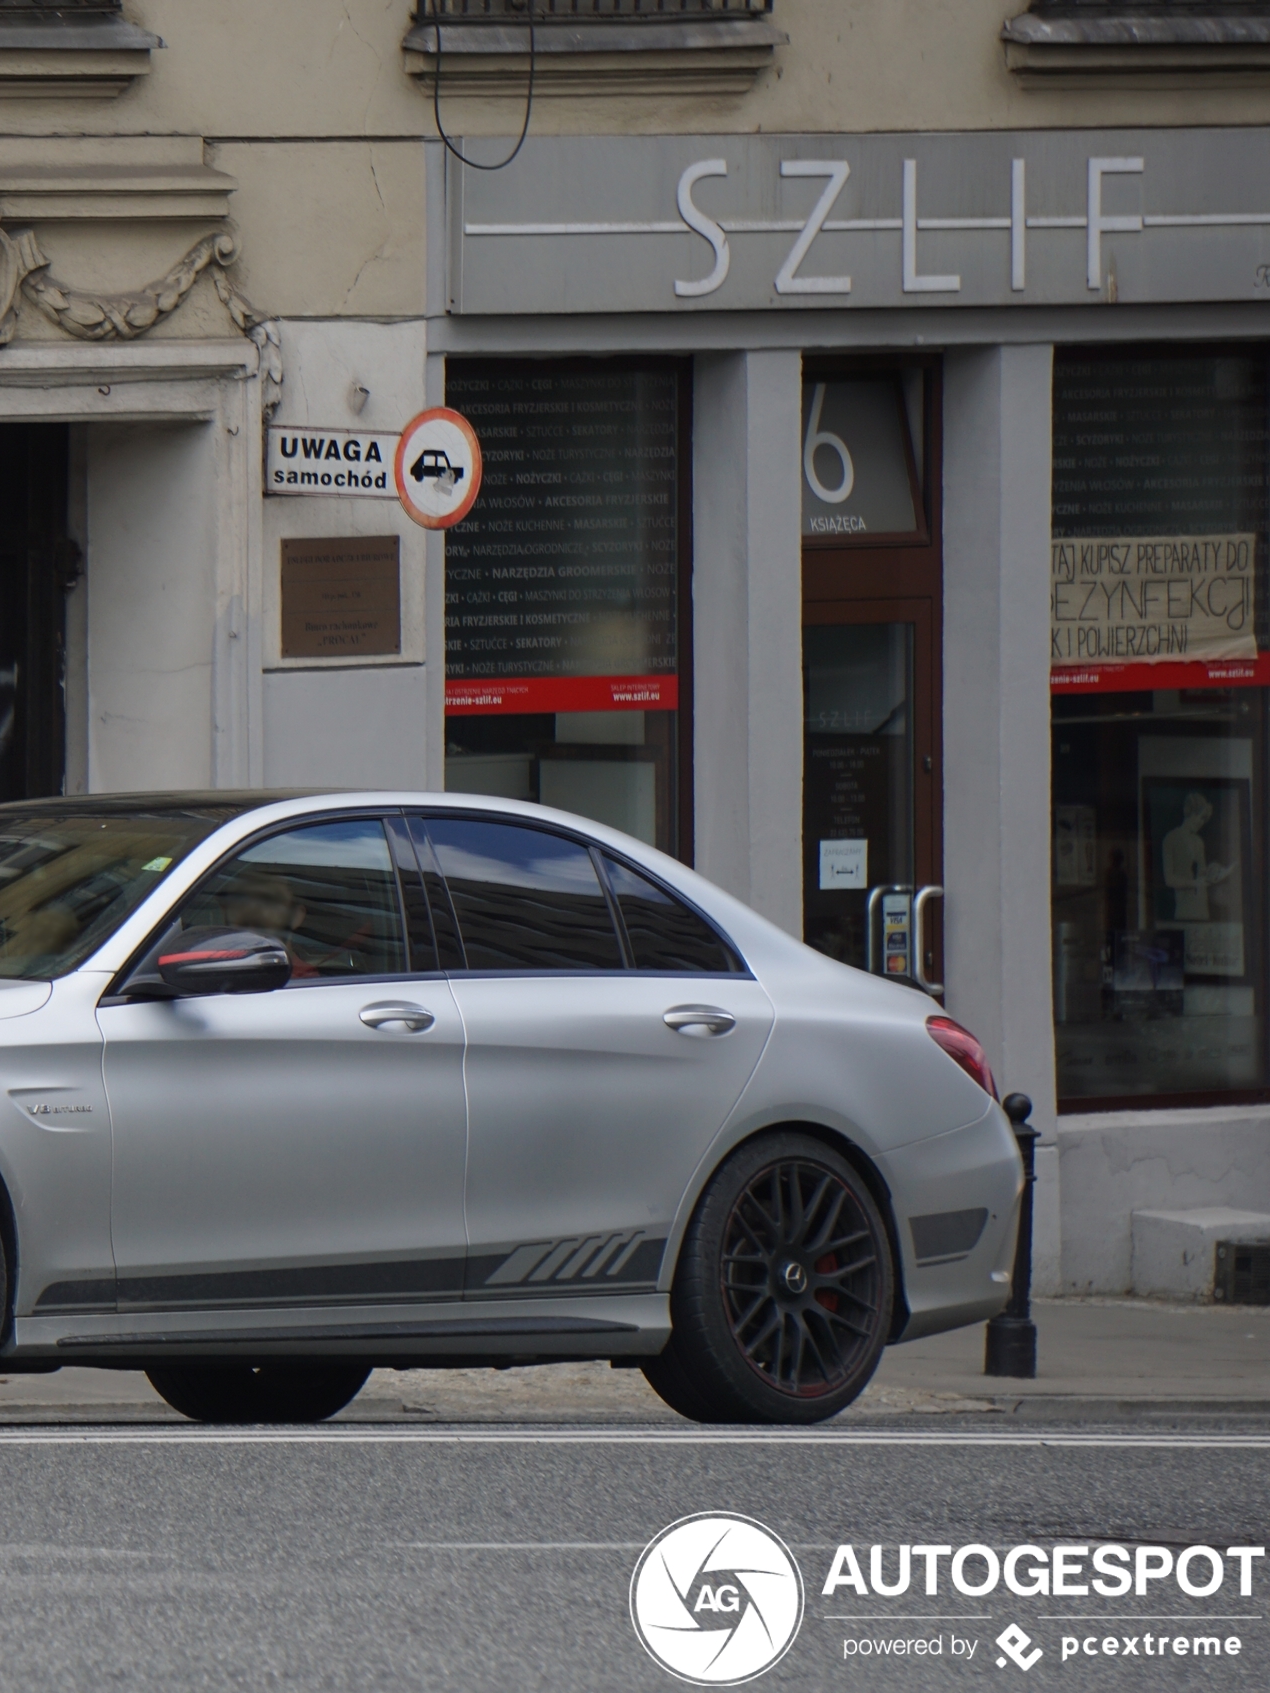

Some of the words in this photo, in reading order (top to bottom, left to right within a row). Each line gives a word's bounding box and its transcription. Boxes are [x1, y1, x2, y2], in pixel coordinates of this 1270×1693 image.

[674, 157, 1144, 297] SZLIF
[532, 377, 552, 391] CĘGI
[461, 402, 510, 414] AKCESORIA
[513, 402, 569, 414] FRYZJERSKIE
[476, 425, 517, 438] ASARSKIE
[572, 424, 618, 436] SEKATORY
[281, 437, 382, 463] UWAGA
[804, 382, 854, 504] 6
[532, 447, 555, 460] NOŻE
[274, 470, 387, 488] samochód
[484, 473, 507, 485] NOŻE
[516, 471, 562, 484] NOŻYCZKI
[489, 495, 535, 509] WŁOSÓW
[545, 494, 602, 507] AKCESORIA
[606, 493, 669, 505] FRYZJERSKIE
[489, 518, 514, 532] NOŻE
[516, 517, 564, 531] KUCHENNE
[574, 517, 627, 529] MASARSKIE
[810, 514, 866, 534] KSIĄŻĘCA
[473, 544, 523, 558] NARZĘDZIA
[525, 542, 584, 554] OGRODNICZE
[1081, 543, 1131, 575] KUPISZ
[1137, 542, 1221, 574] PREPARATY
[1226, 540, 1249, 572] DO
[492, 566, 555, 580] NARZĘDZIA
[559, 565, 636, 577] GROOMERSKIE
[647, 563, 675, 574] NOŻE
[498, 590, 517, 604] CĘGI
[569, 589, 581, 600] DO
[1051, 576, 1250, 631] EZYNFEKCJI
[463, 614, 517, 626] FRYZJERSKIE
[526, 613, 590, 625] KOSMETYCZNE
[470, 637, 507, 651] SZTUĆCE
[516, 637, 562, 649] SEKATORY
[1078, 624, 1187, 658] POWIERZCHNI
[472, 661, 495, 673] NOŻE
[498, 660, 554, 672] TURYSTYCZNE
[613, 691, 660, 702] www.szlif.eu
[819, 710, 871, 728] SZLIF
[26, 1103, 51, 1115] V8
